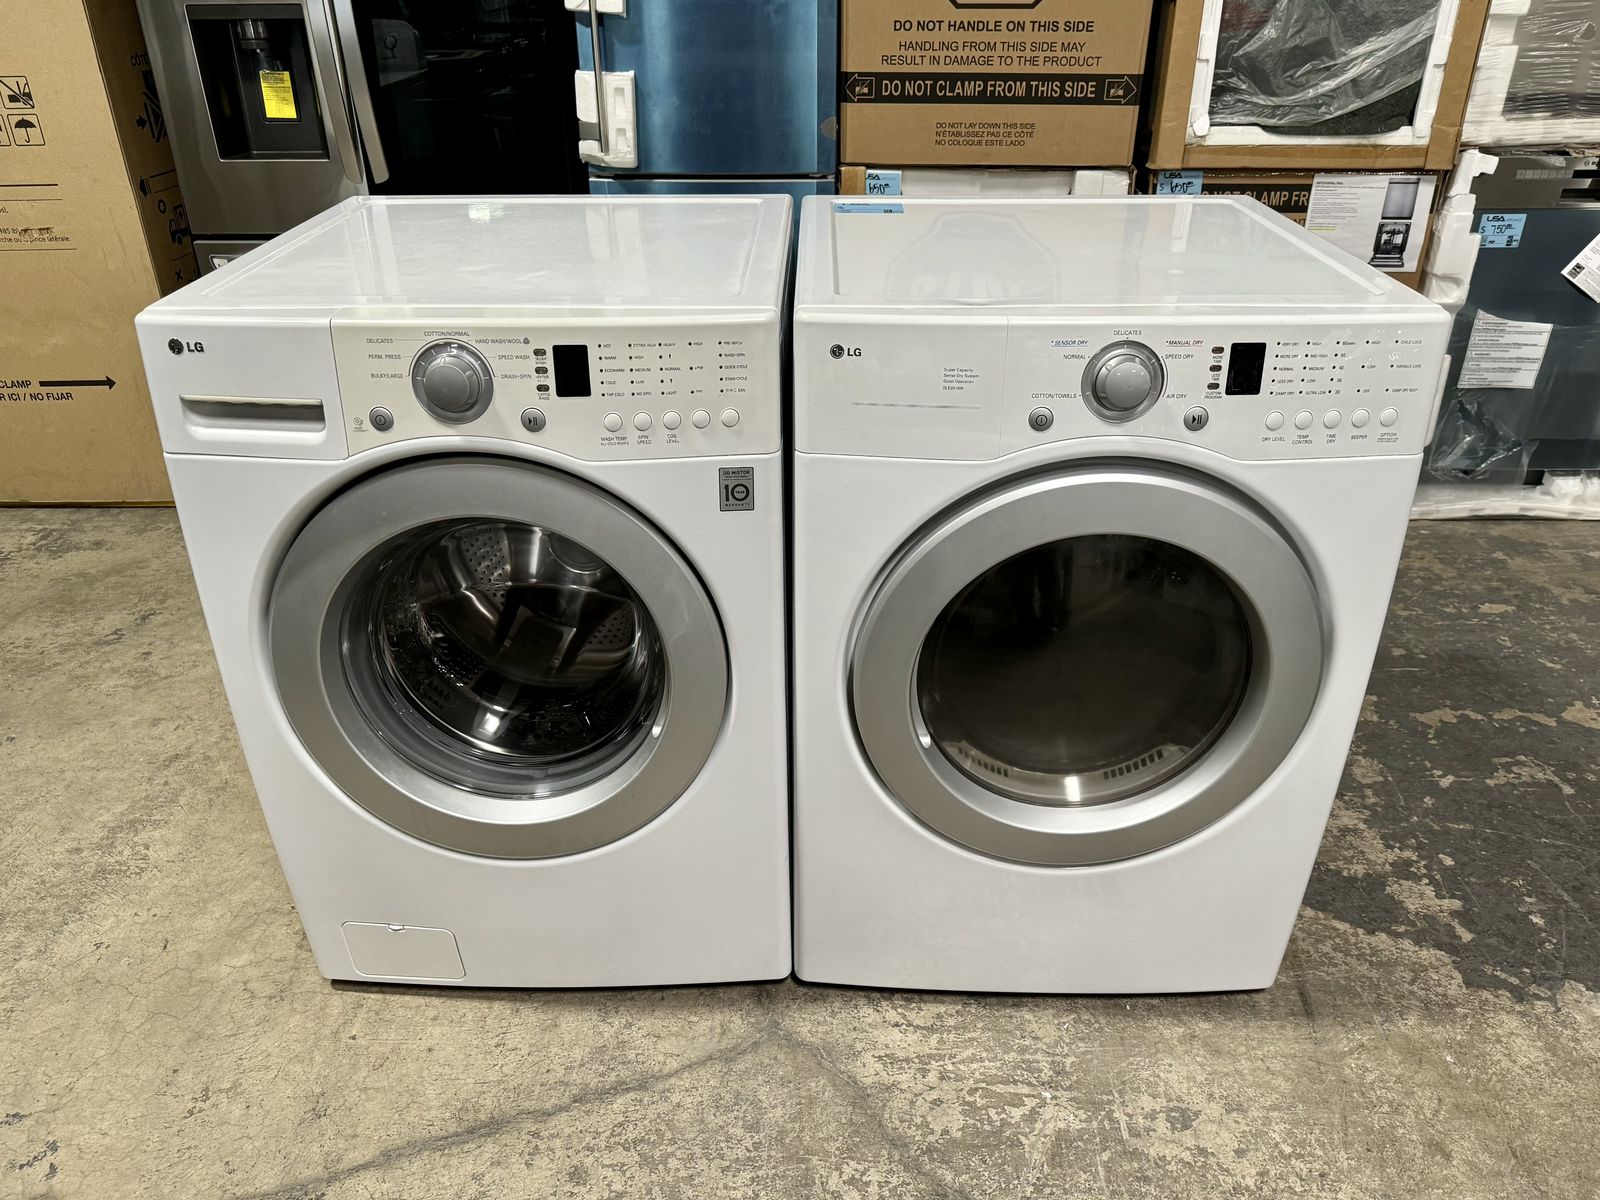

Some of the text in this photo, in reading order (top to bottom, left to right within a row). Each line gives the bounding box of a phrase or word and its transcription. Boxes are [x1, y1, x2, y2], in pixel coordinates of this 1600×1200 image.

[893, 20, 1095, 33] DO NOT HANDLE ON THIS SIDE
[899, 41, 1087, 52] HANDLING FROM THIS SIDE MAY
[881, 54, 1103, 67] RESULT IN DAMAGE TO THE PRODUCT
[882, 80, 1097, 98] DO NOT CLAMP FROM THIS SIDE
[964, 122, 978, 130] LAY
[978, 122, 1001, 130] DOWN
[1002, 122, 1018, 130] THIS
[1019, 122, 1036, 130] SIDE
[935, 129, 1035, 139] N'ÉTABLISSEZ PAS CE CÔTÉ
[947, 139, 984, 147] COLOQUE
[984, 139, 1004, 147] ESTE
[1005, 139, 1026, 147] LADO
[1490, 224, 1507, 234] 750
[186, 341, 205, 353] LG
[846, 347, 862, 357] LG
[0, 380, 32, 389] CLAMP
[8, 393, 21, 401] ICI
[29, 392, 44, 401] NO
[46, 392, 74, 401] FIJAR
[724, 483, 750, 502] 10
